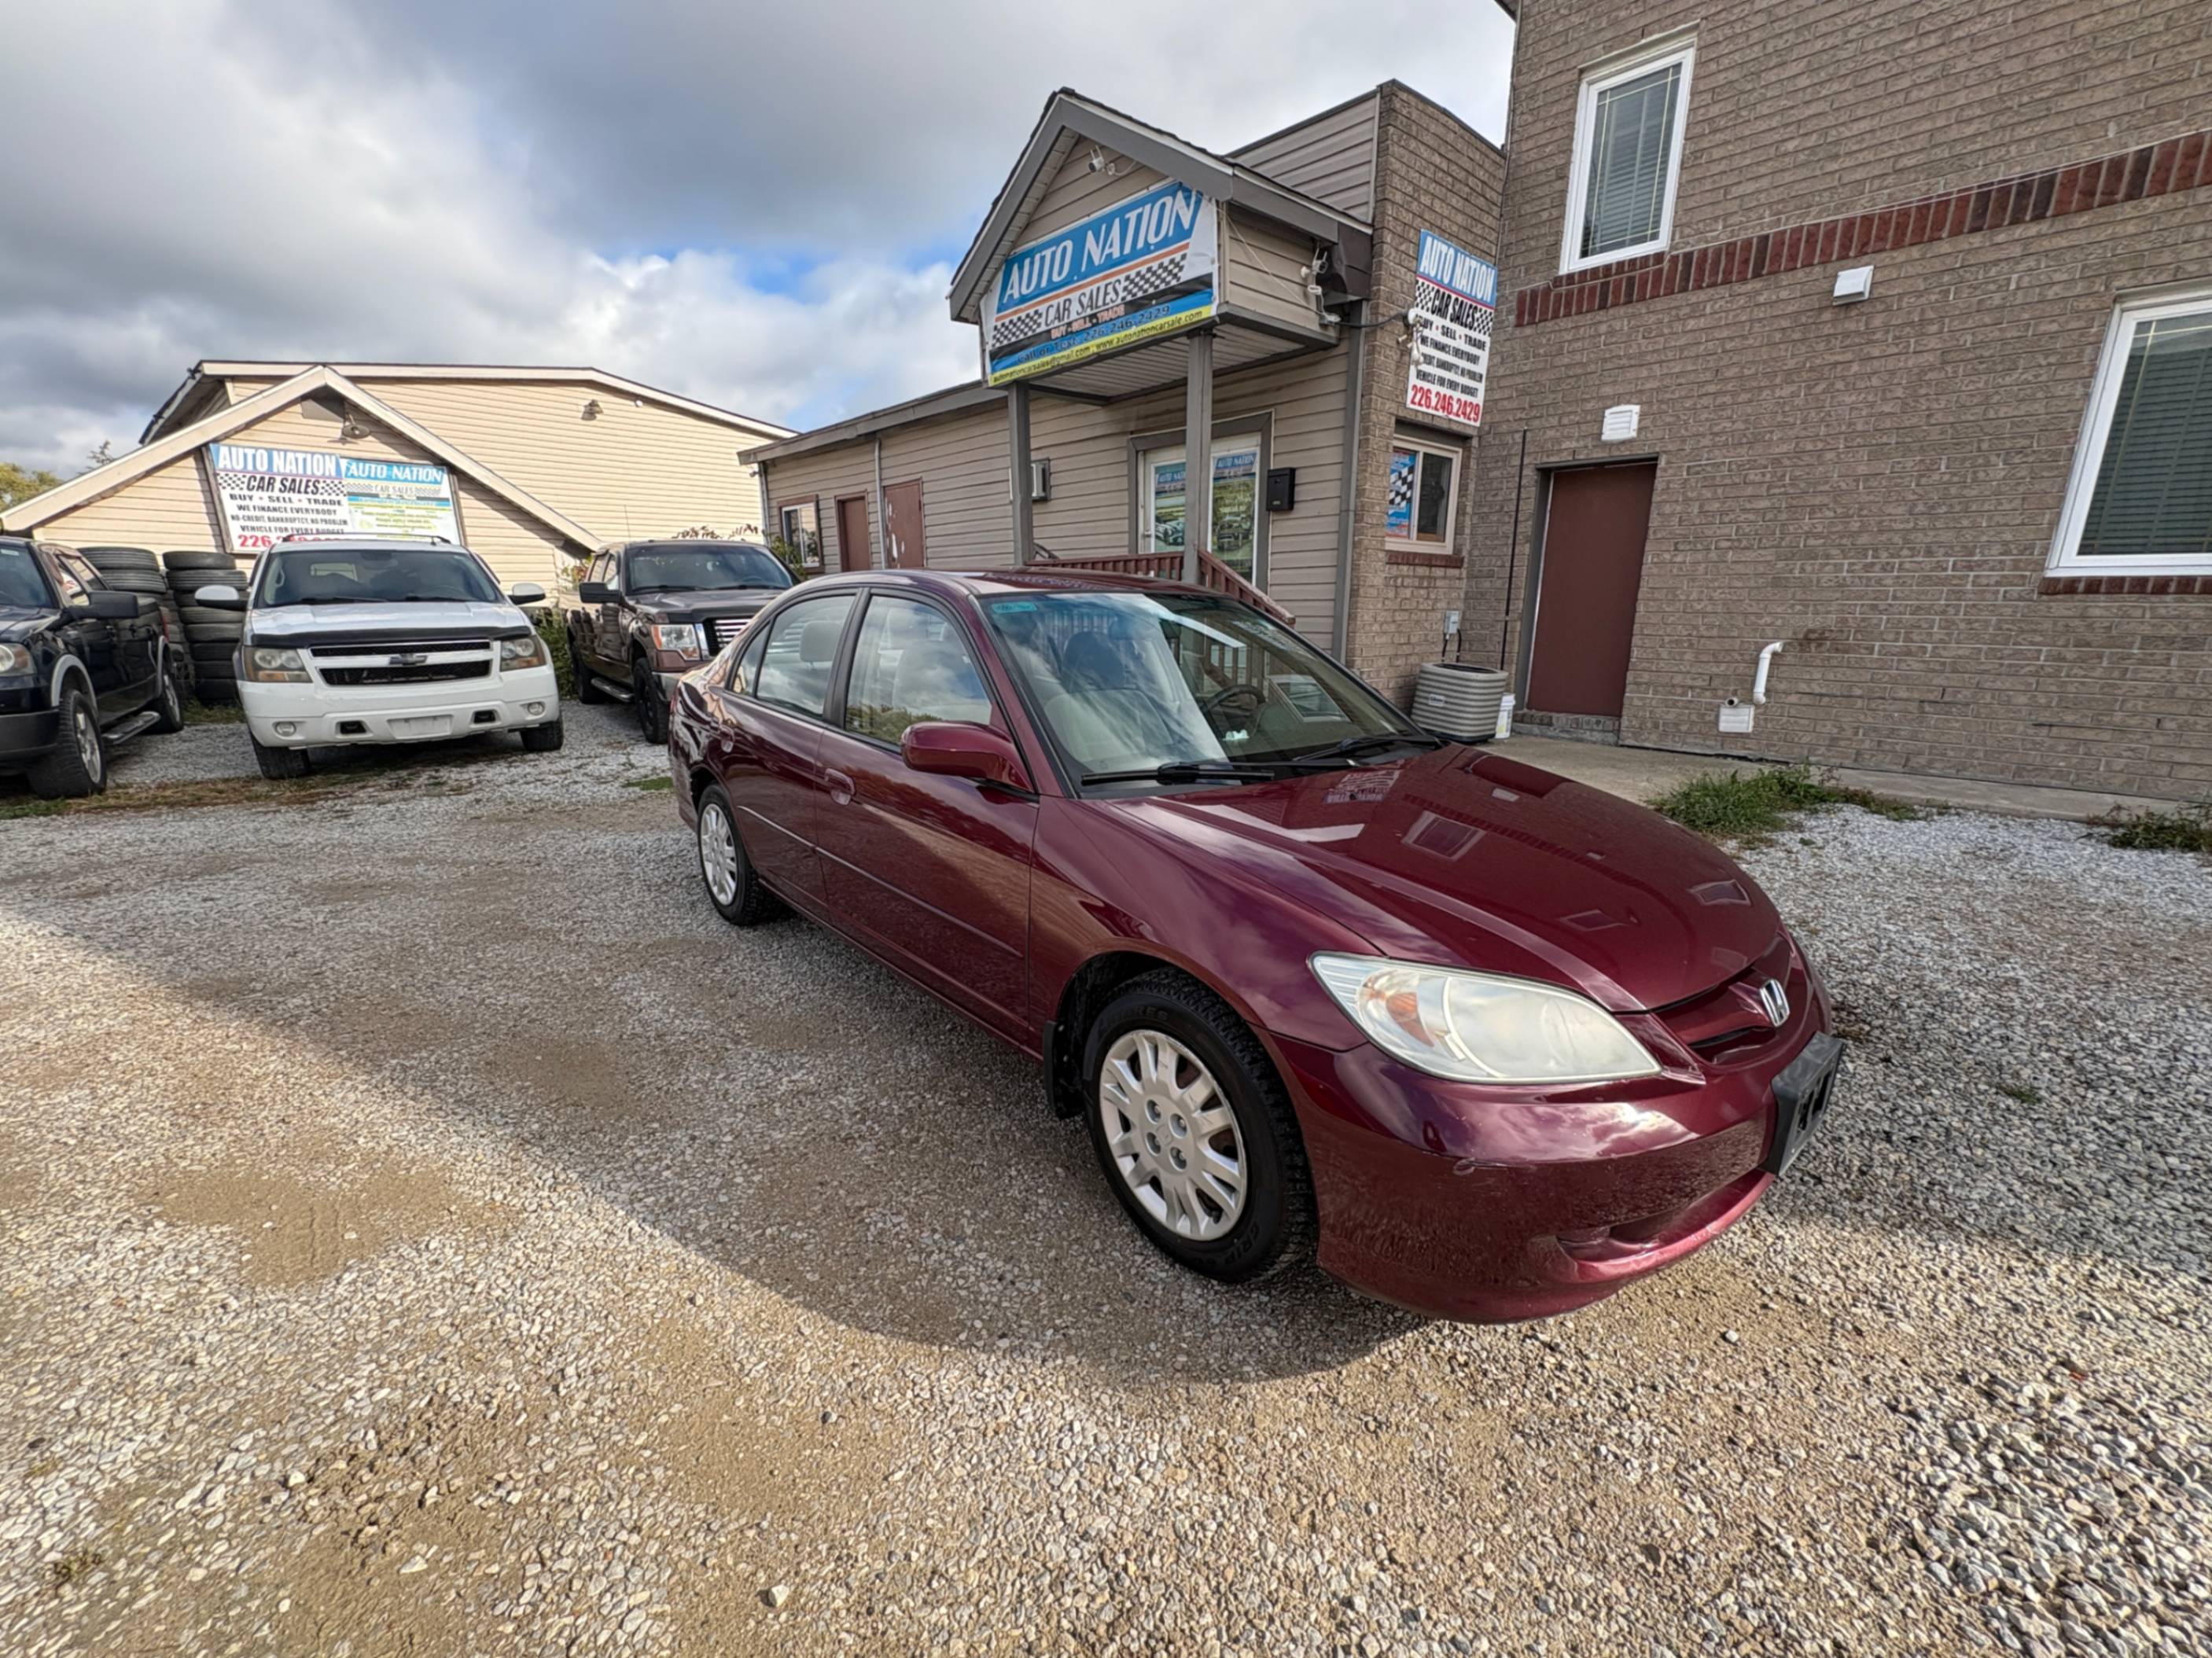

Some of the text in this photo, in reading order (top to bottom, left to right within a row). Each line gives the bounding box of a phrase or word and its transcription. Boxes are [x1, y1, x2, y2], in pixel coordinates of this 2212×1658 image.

[1003, 189, 1197, 303] AUTO NATION
[1419, 235, 1496, 303] AUTO NATION
[1044, 279, 1121, 328] CAR SALES
[1430, 288, 1479, 331] CAR SALES
[1051, 325, 1068, 340] BUY
[1098, 303, 1125, 322] TRADE
[1420, 333, 1480, 366] WE FINANCE EVERYBODY
[1441, 325, 1457, 341] SELL
[1463, 333, 1487, 352] TRADE
[1018, 350, 1036, 364] Call
[1040, 347, 1050, 357] or
[1416, 368, 1479, 399] VEHICLE FOR EVERY BUDGET
[1410, 384, 1481, 423] 226.246.2429
[217, 445, 337, 477] AUTO NATION
[348, 460, 442, 483] AUTO NATION
[229, 493, 344, 506] BUY SELL TRADE
[246, 475, 321, 495] CAR SALES
[392, 485, 414, 494] SALES
[252, 505, 289, 514] FINANCE
[290, 506, 337, 516] EVERYBODY
[240, 524, 273, 533] VEHICLE
